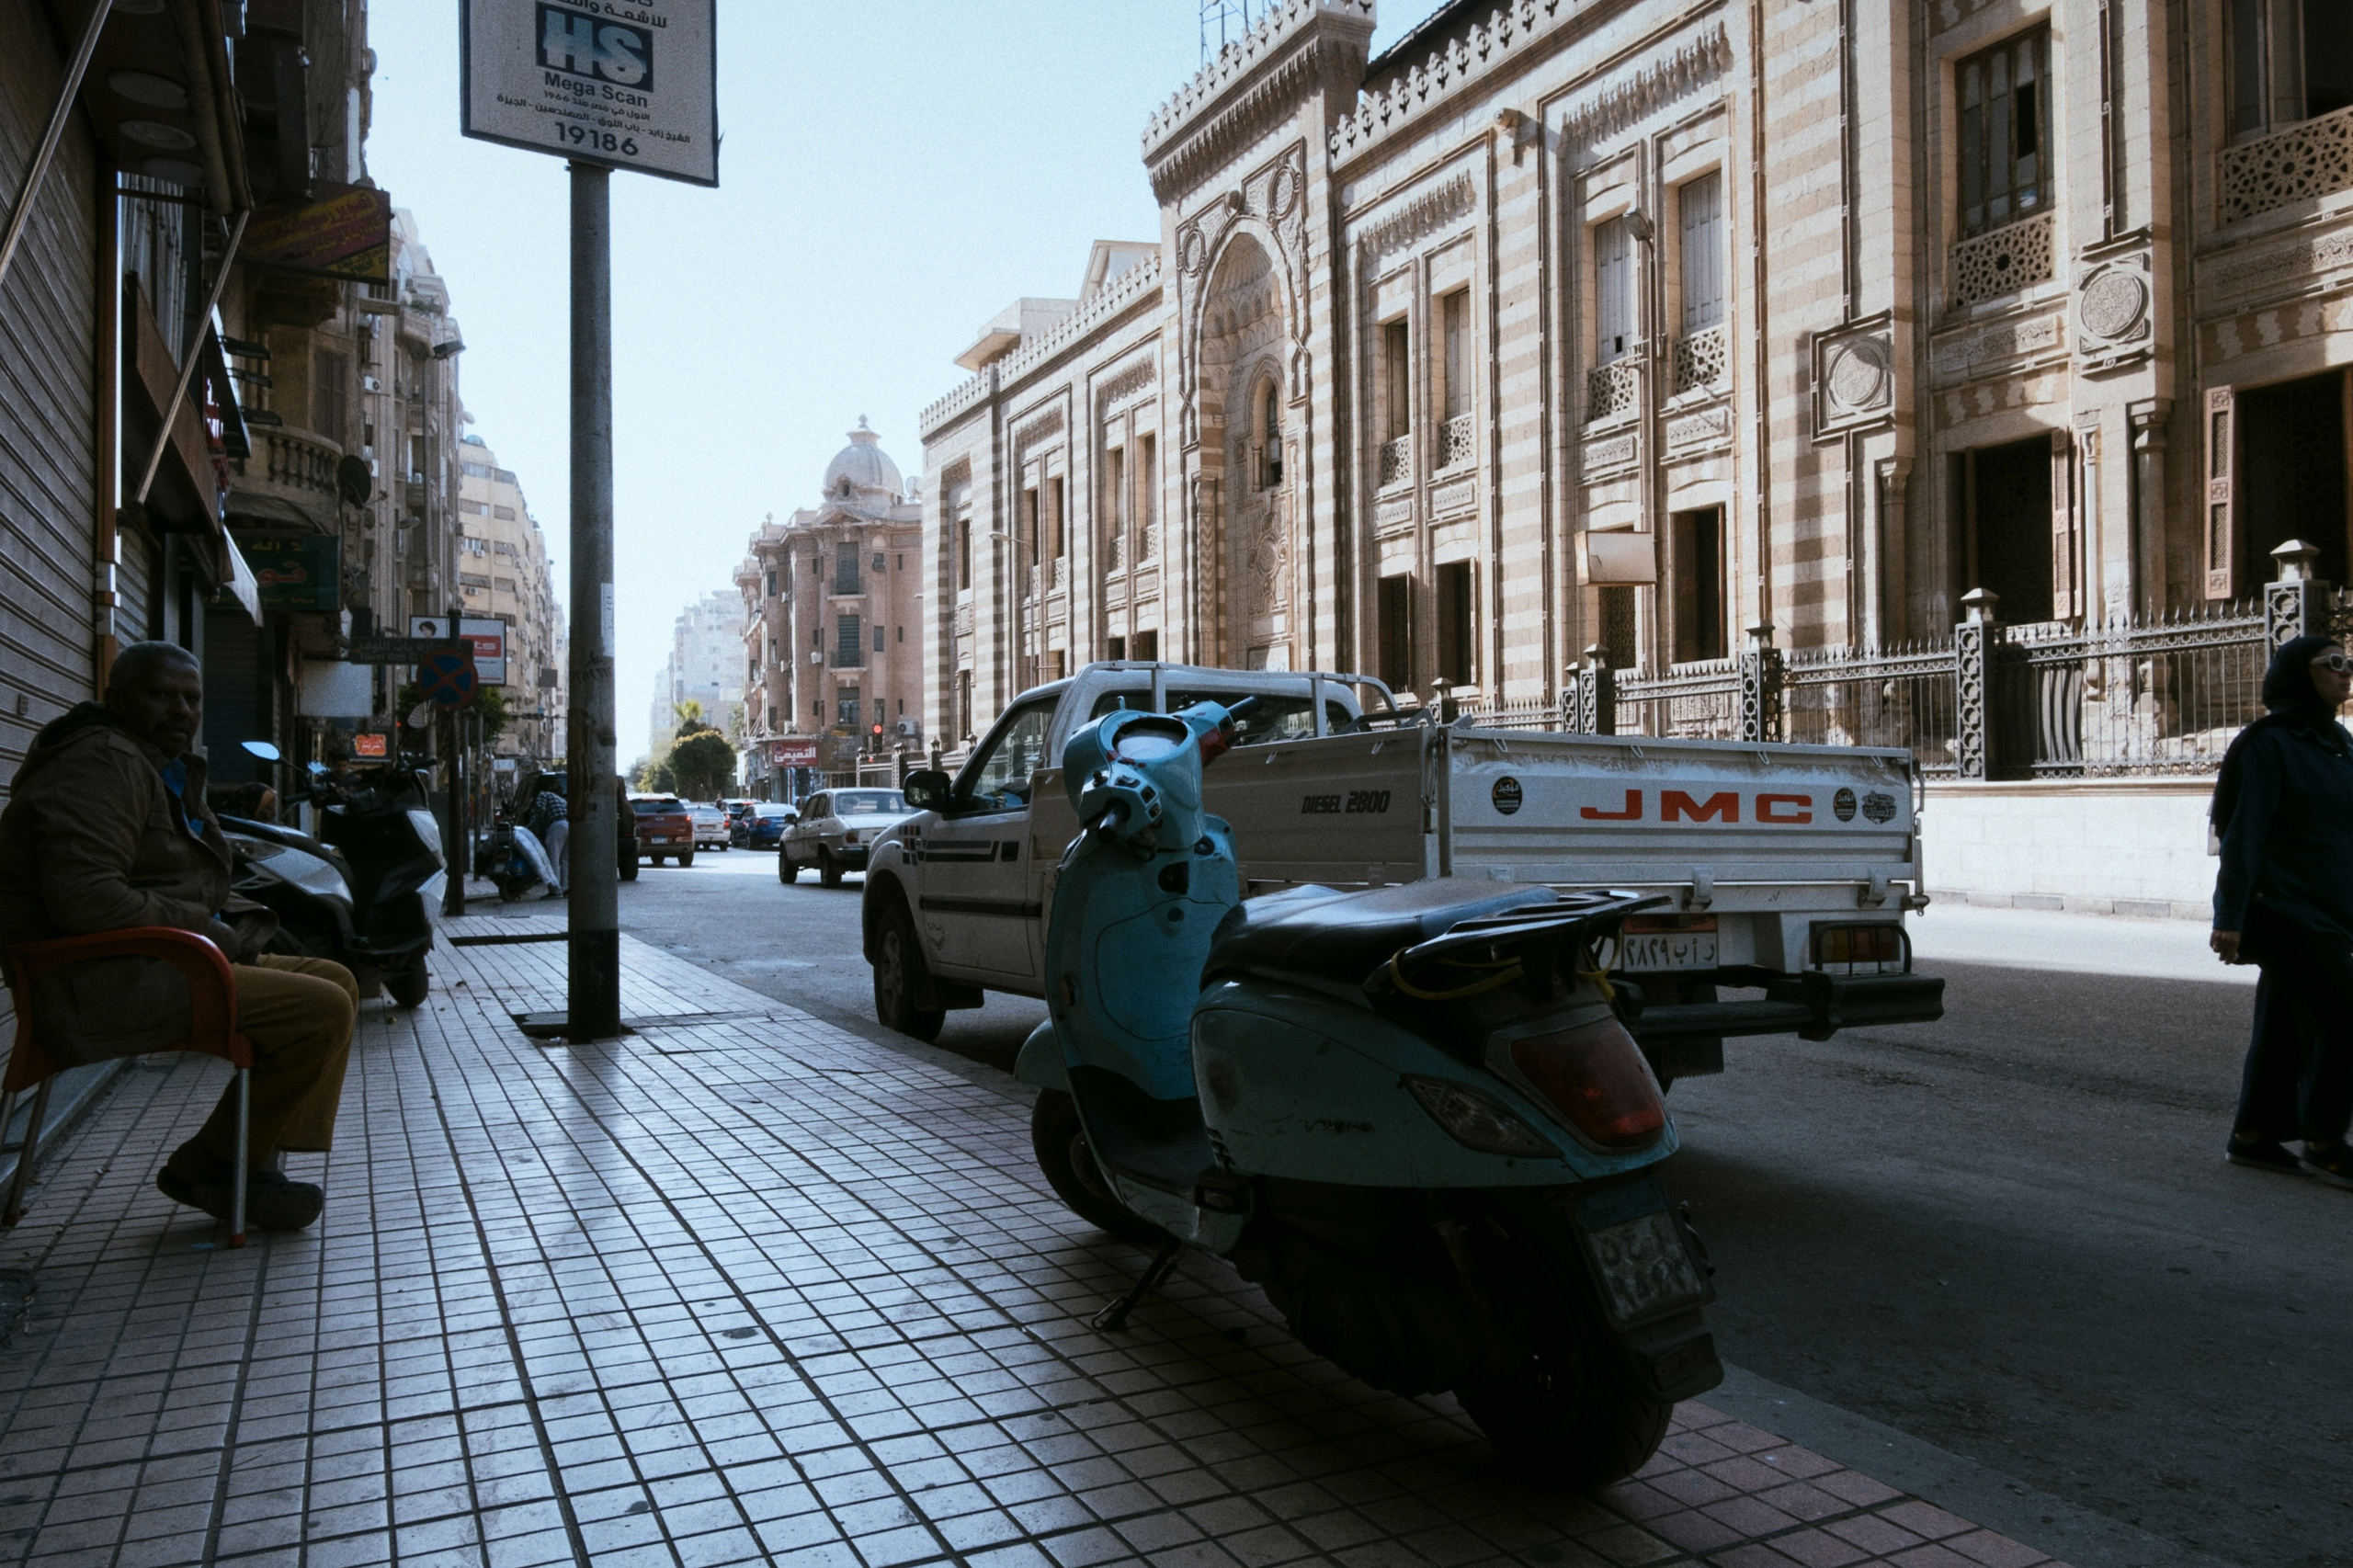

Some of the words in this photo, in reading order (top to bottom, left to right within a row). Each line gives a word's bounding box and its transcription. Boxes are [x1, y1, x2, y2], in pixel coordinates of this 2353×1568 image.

[497, 94, 527, 108] الجيزة
[544, 72, 596, 97] Mega
[602, 85, 648, 108] Scan
[544, 90, 570, 102] 1966
[591, 102, 609, 112] مصر
[555, 121, 639, 156] 19186
[388, 652, 407, 661] Bab
[1302, 795, 1342, 814] DIESEL
[1345, 790, 1391, 813] 2800
[1579, 789, 1813, 824] JMC
[1674, 943, 1688, 965] ب
